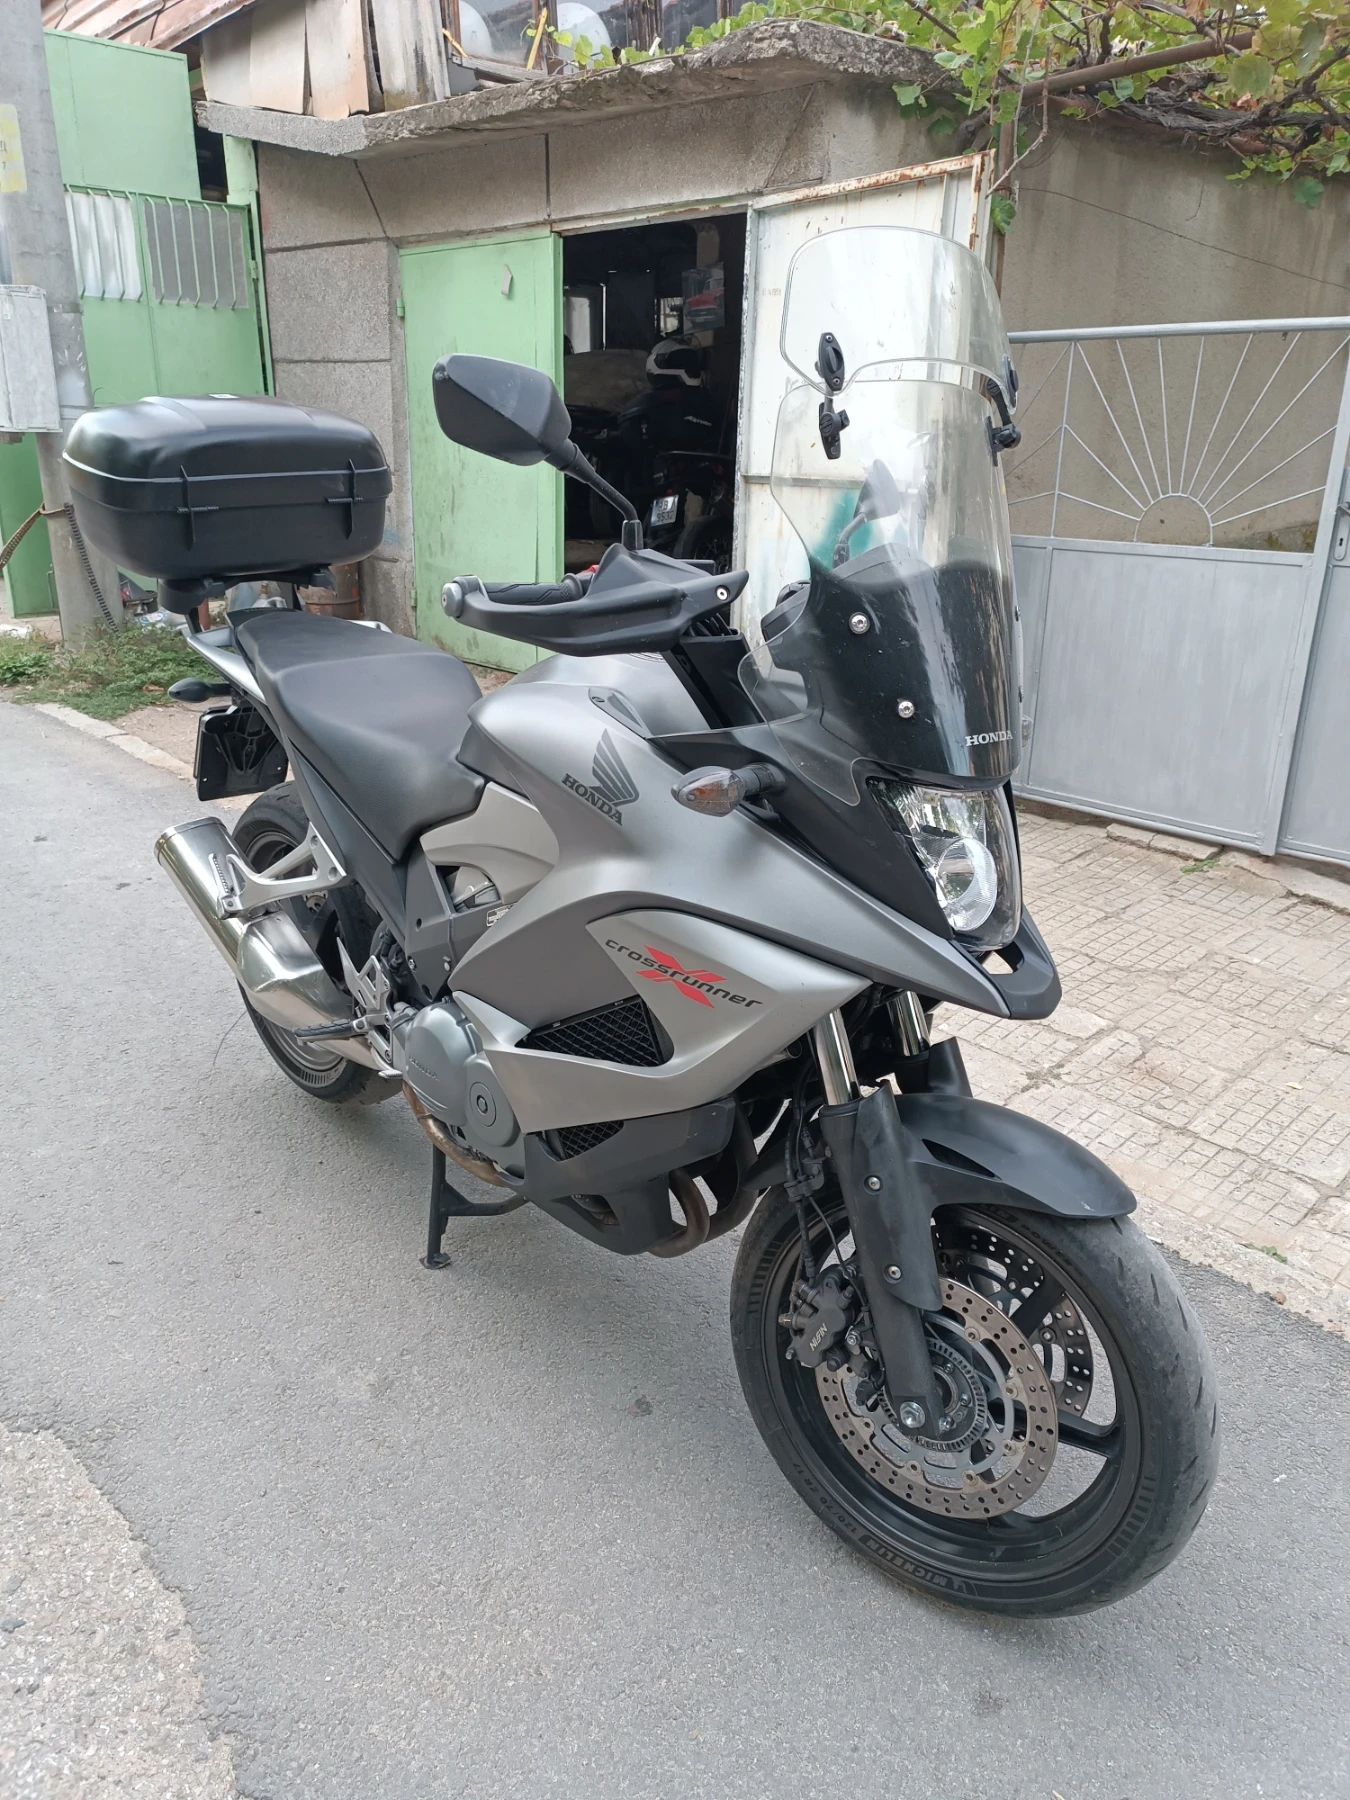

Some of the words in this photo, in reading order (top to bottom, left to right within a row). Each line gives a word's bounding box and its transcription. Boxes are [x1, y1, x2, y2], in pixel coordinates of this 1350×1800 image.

[965, 730, 1013, 747] HONDA
[561, 773, 624, 826] HONDA
[604, 938, 763, 1008] crossrunner
[865, 1538, 948, 1587] MICHELIN
